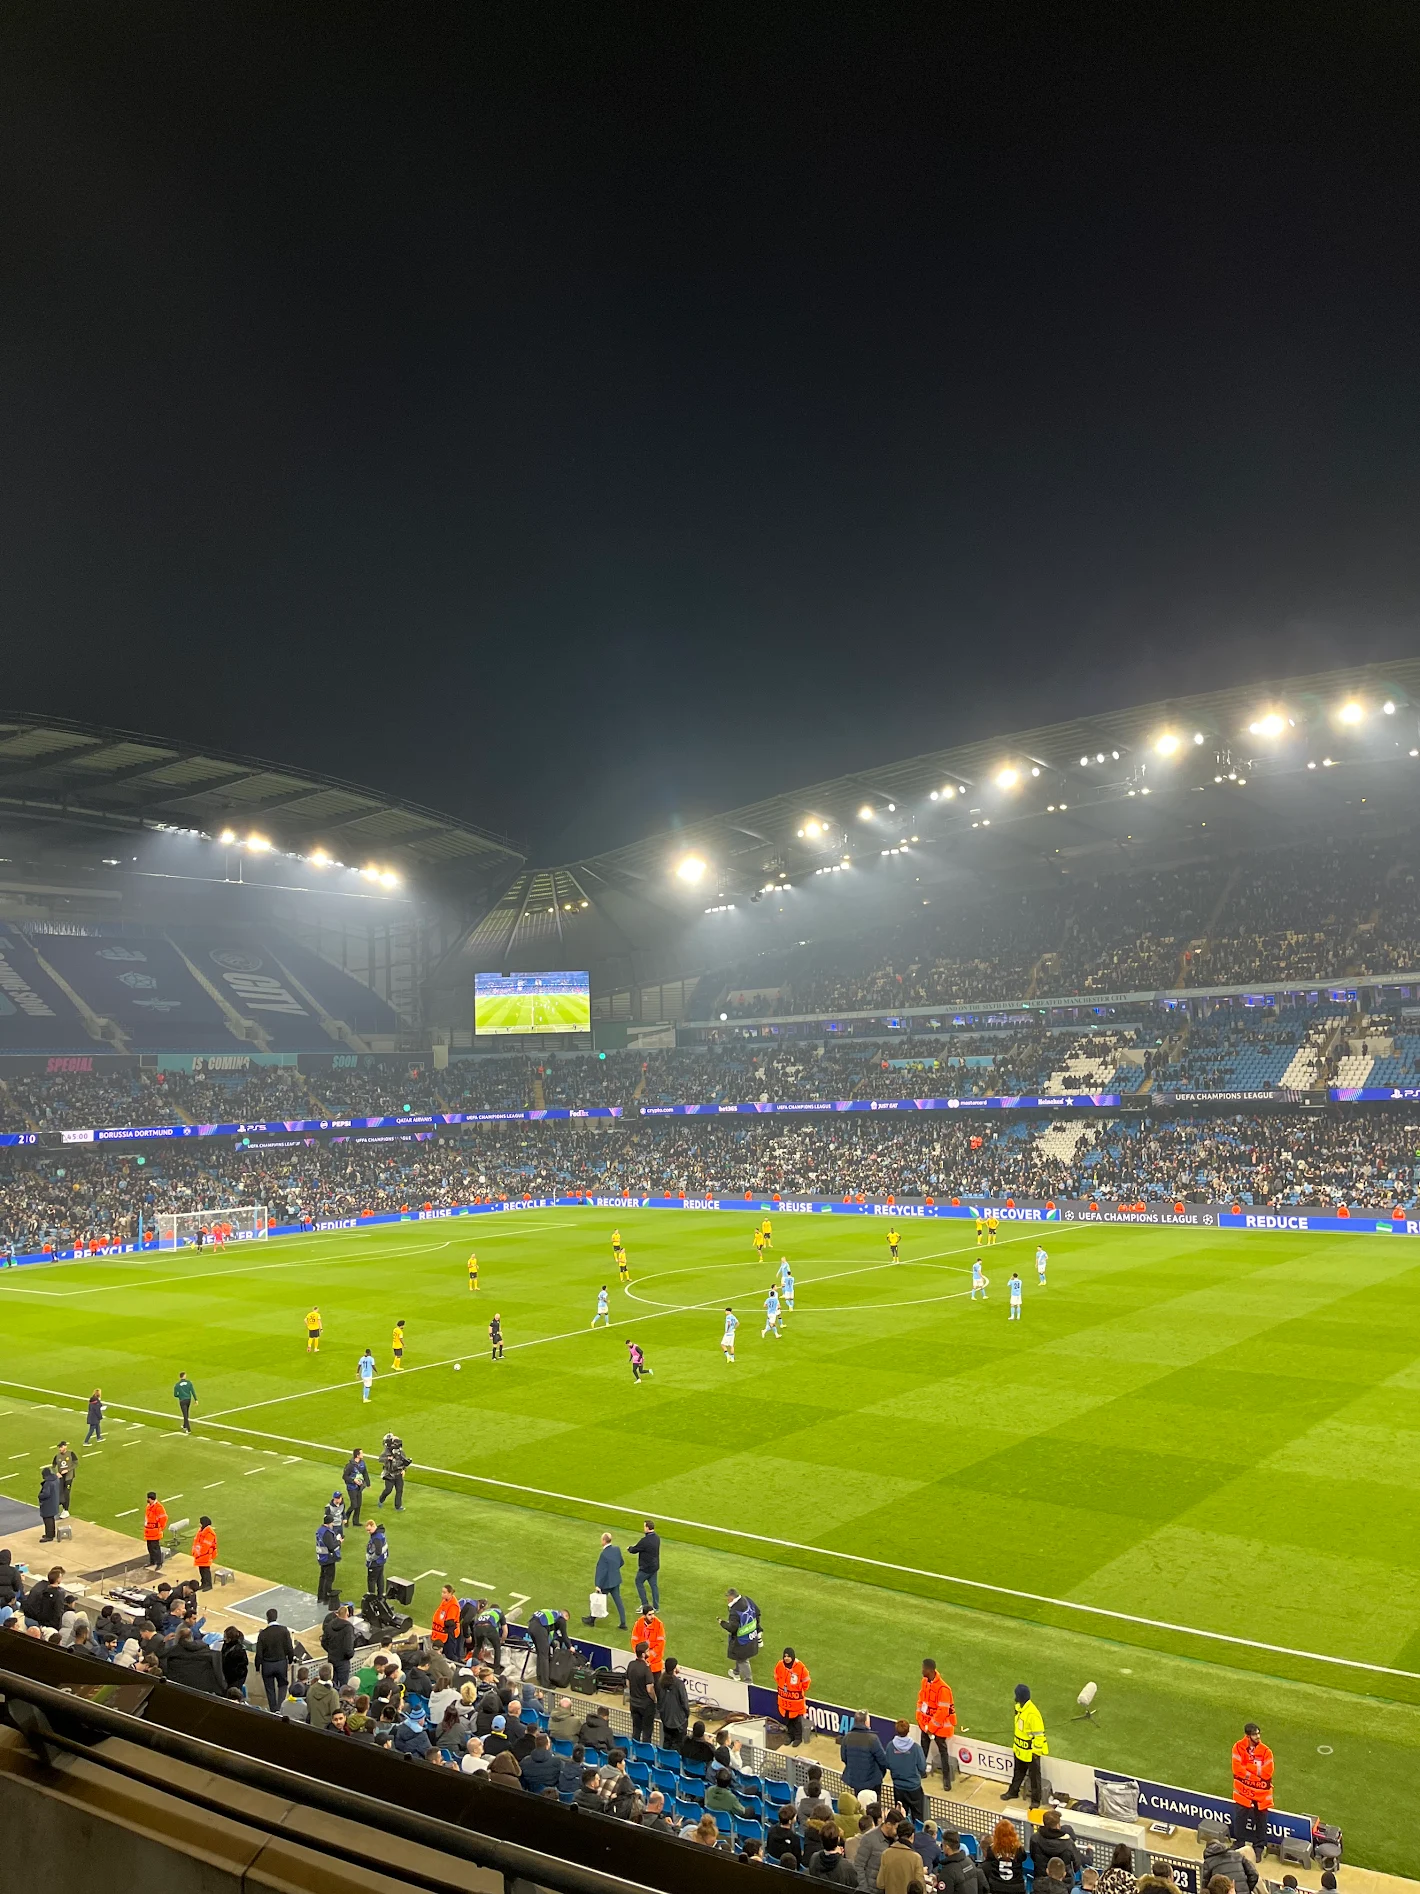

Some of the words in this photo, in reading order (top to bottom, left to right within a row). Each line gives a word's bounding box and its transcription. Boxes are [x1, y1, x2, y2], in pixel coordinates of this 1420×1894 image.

[223, 973, 310, 1017] CITY
[1064, 996, 1109, 1005] MANCHESTER
[47, 1057, 93, 1072] SPECIAL
[192, 1057, 203, 1070] IS
[332, 1055, 358, 1068] SOON
[1196, 1092, 1241, 1100] CHAMPIONS
[1243, 1091, 1274, 1099] LEAGUE
[569, 1109, 589, 1117] FedEx
[99, 1131, 133, 1139] BORUSSIA
[134, 1129, 173, 1137] DORTMUND
[247, 1124, 267, 1132] PS5
[503, 1199, 547, 1211] RECYCLE
[597, 1197, 639, 1208] RECOVER
[683, 1199, 720, 1210] REDUCE
[778, 1201, 813, 1213] REUSE
[419, 1209, 452, 1221] REUSE
[873, 1204, 925, 1216] RECYCLE
[983, 1207, 1042, 1220] RECOVER
[1078, 1211, 1102, 1221] UEFA
[1104, 1212, 1159, 1223] CHAMPIONS
[1161, 1213, 1198, 1224] LEAGUE
[1246, 1215, 1309, 1229] REDUCE
[1406, 1220, 1420, 1234] R
[978, 1753, 1013, 1772] RESP
[1151, 1796, 1232, 1825] CHAMPIONS
[998, 1861, 1014, 1881] 5
